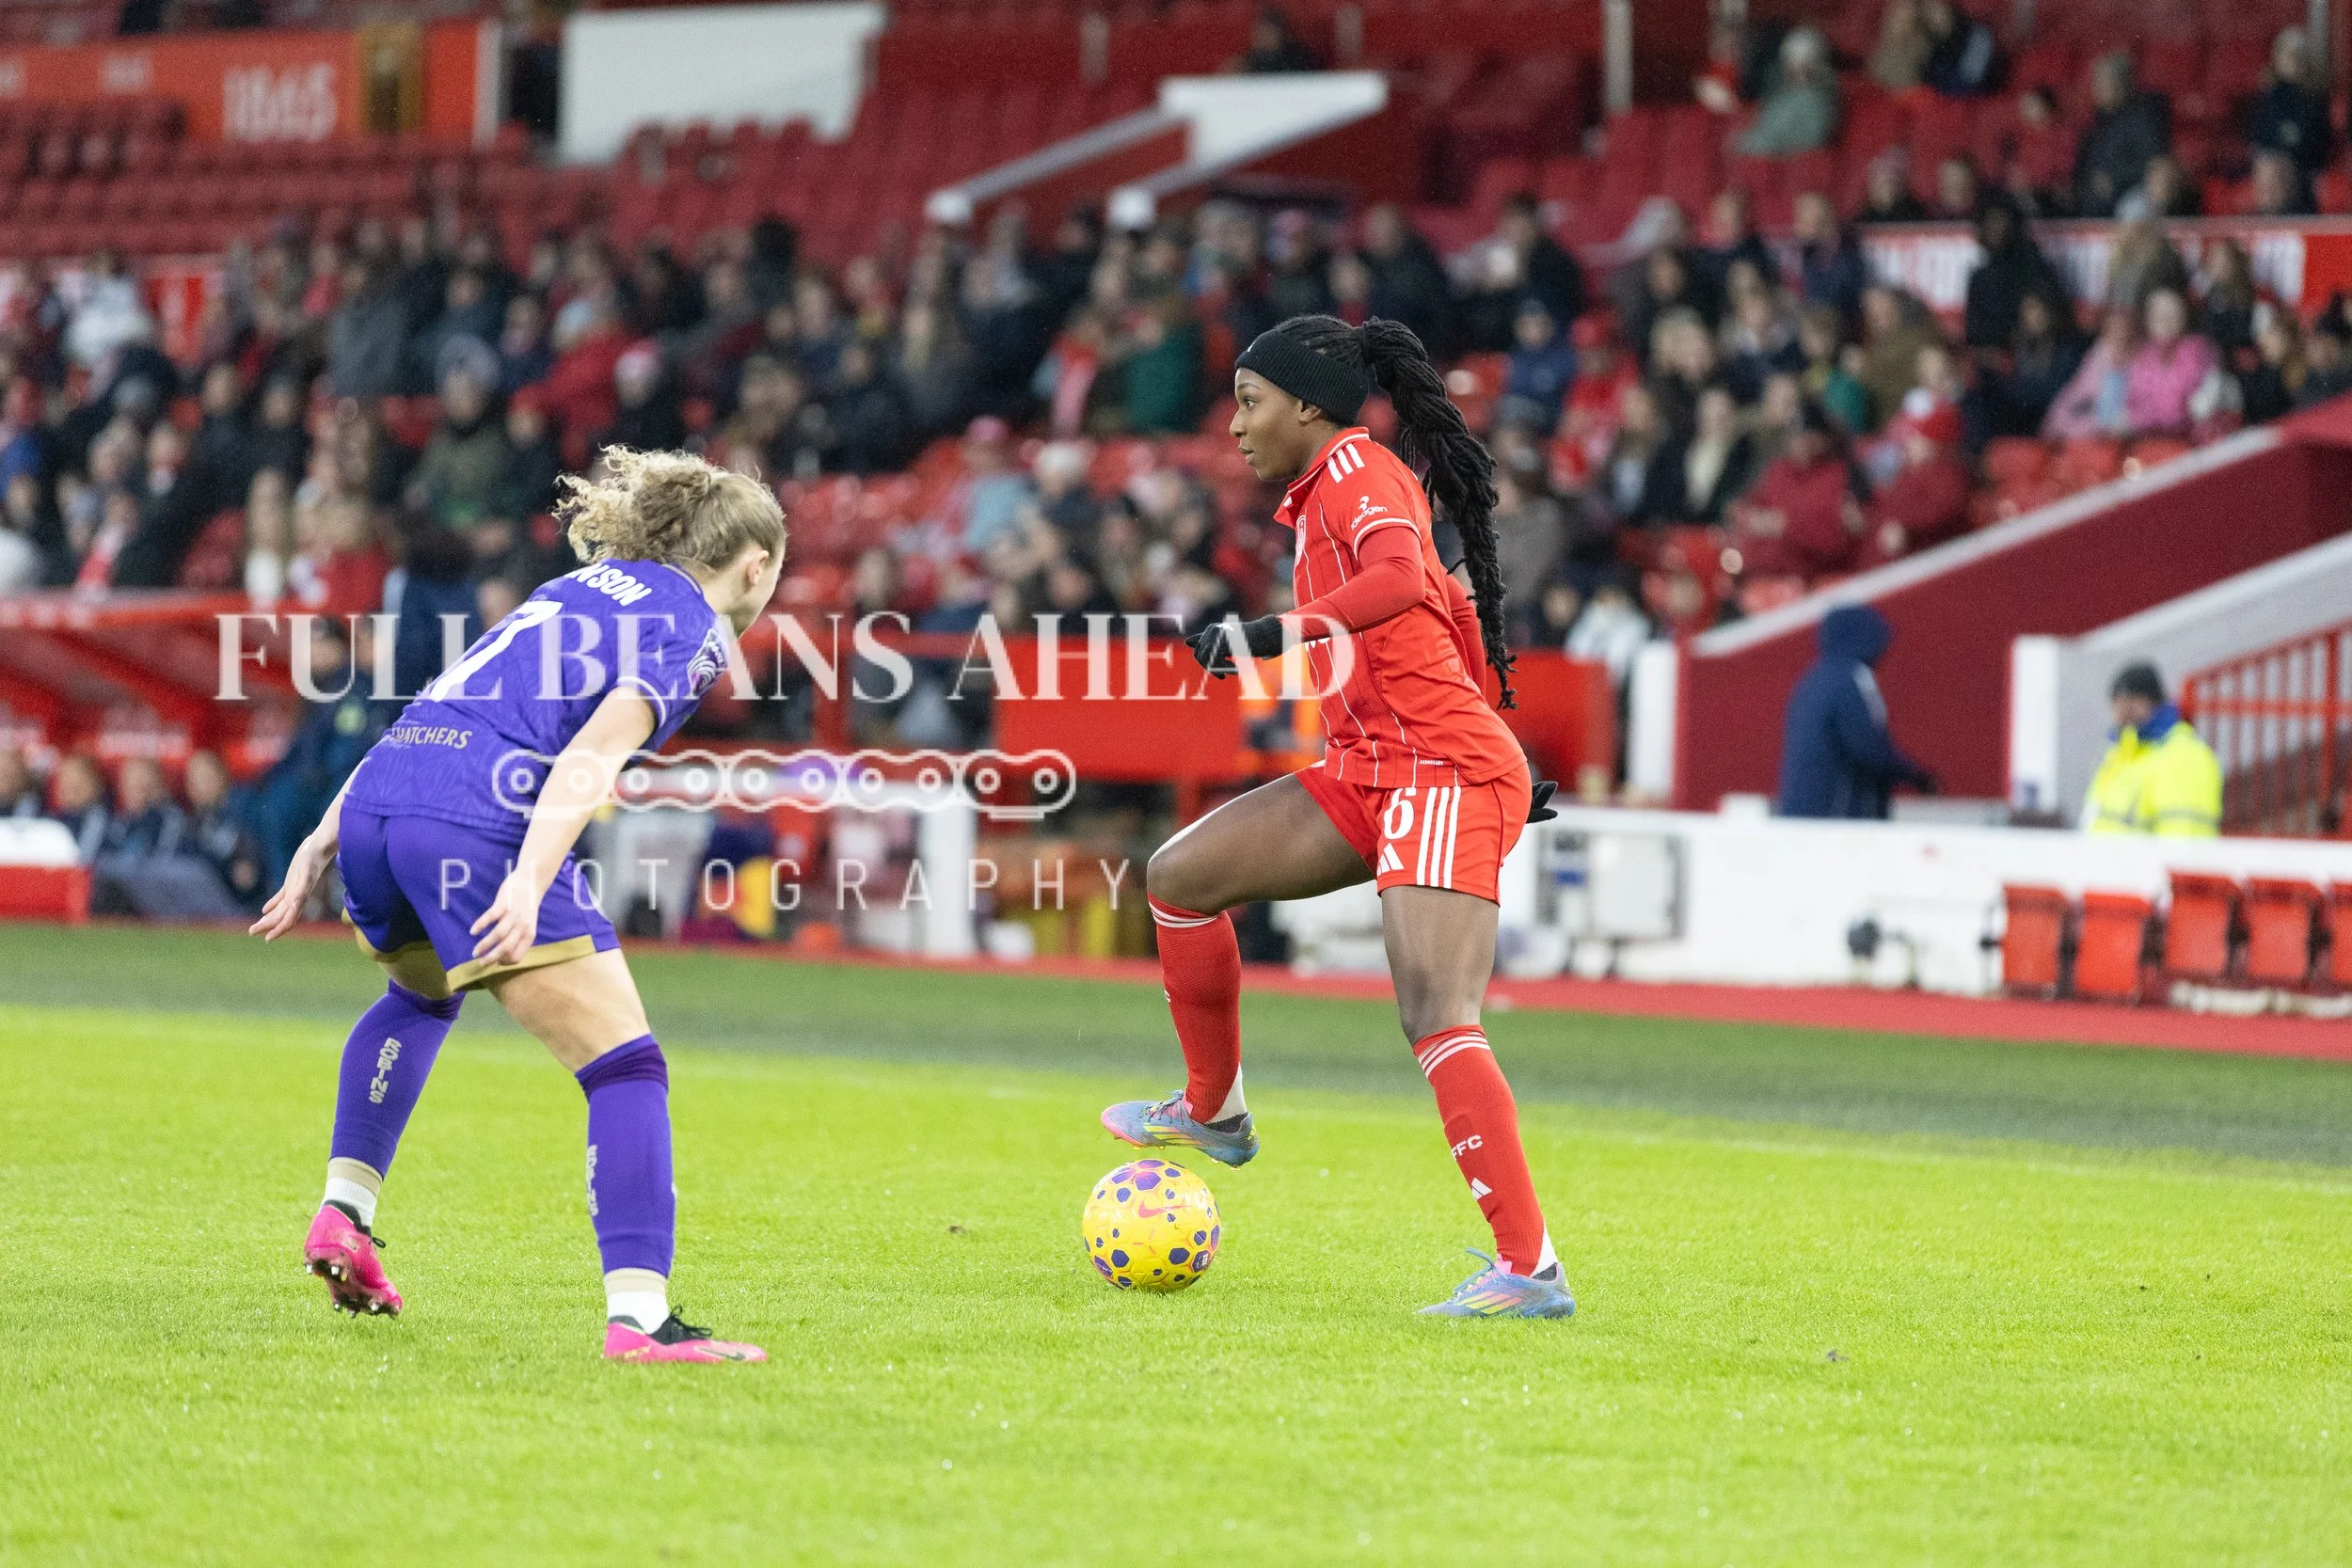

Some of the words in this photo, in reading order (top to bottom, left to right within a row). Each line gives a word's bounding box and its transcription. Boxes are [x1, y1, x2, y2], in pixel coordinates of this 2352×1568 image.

[429, 600, 564, 703] 7
[1383, 787, 1417, 840] 6
[368, 1037, 403, 1104] ROBINS
